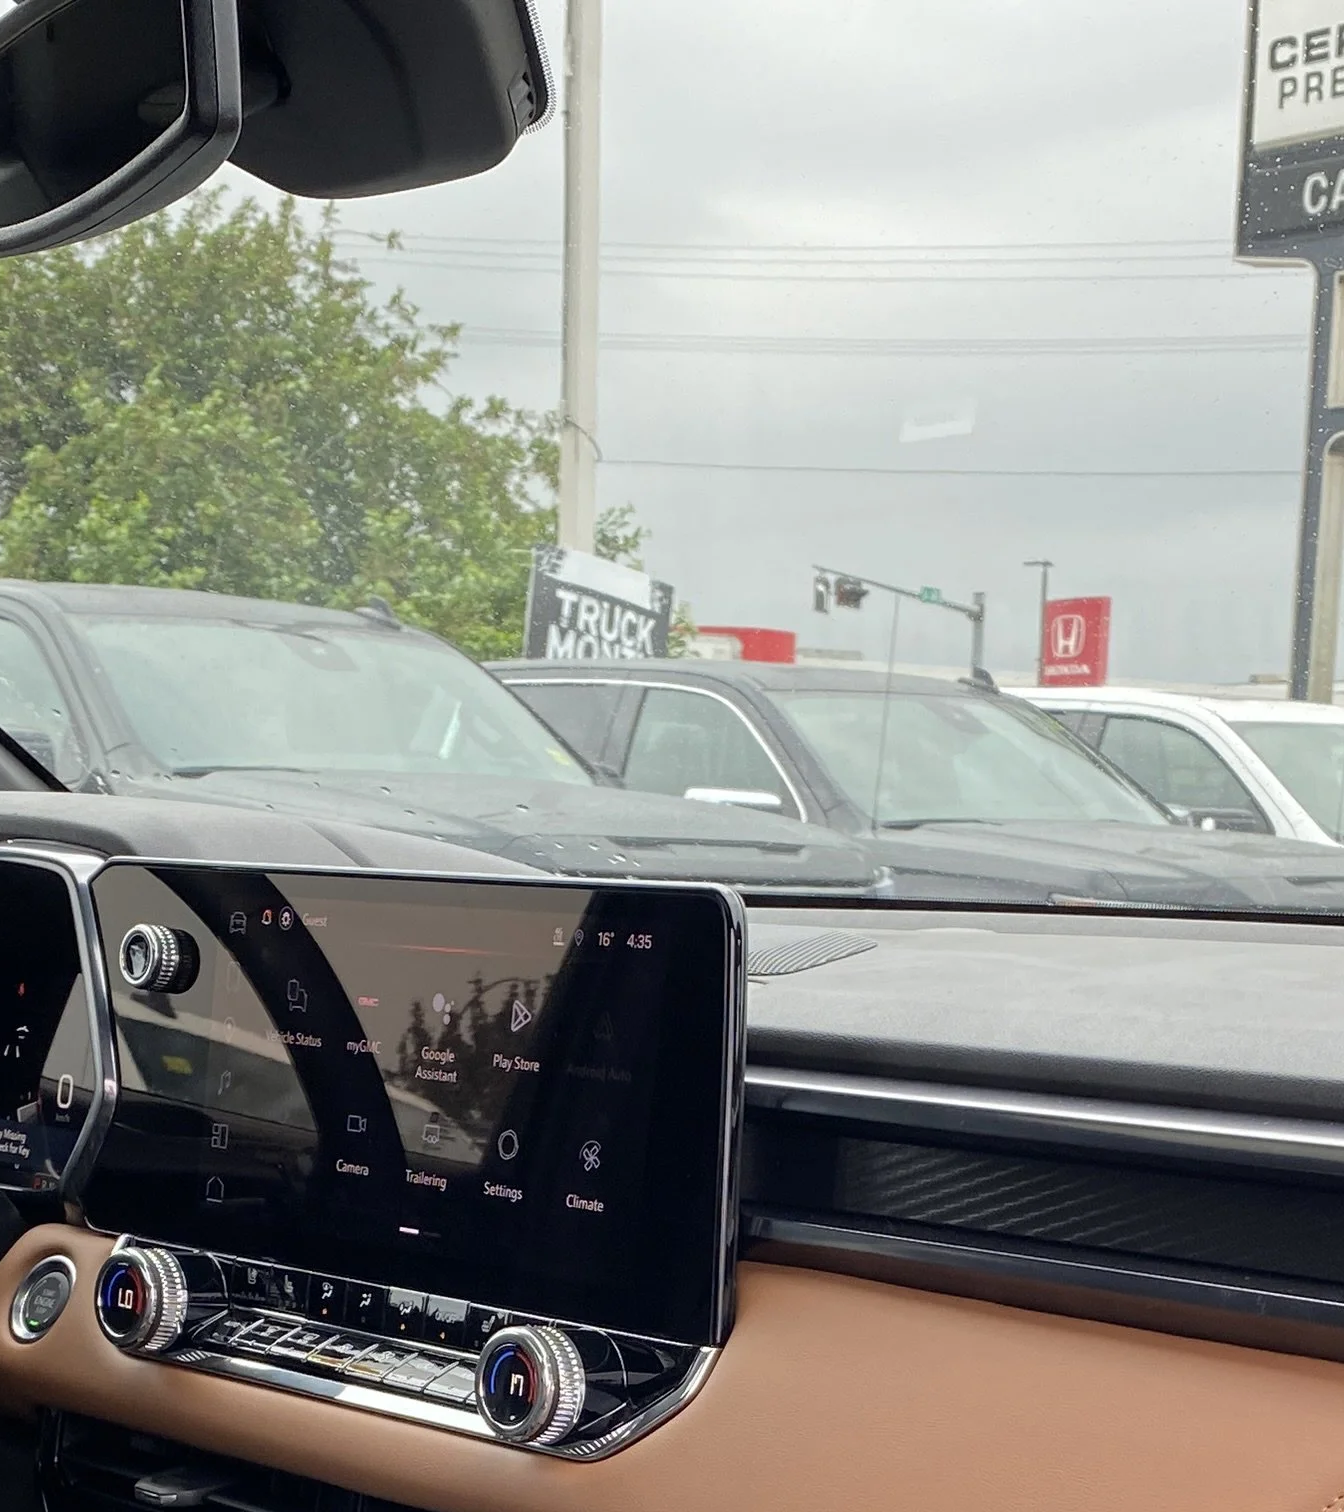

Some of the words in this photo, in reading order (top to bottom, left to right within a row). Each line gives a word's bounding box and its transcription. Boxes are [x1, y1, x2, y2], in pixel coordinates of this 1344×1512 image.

[555, 587, 656, 656] TRUCK
[303, 913, 328, 928] Guest
[627, 933, 653, 949] 4:35
[266, 1029, 295, 1046] Vehicle
[296, 1032, 322, 1048] Status
[346, 1039, 381, 1054] myGMC
[421, 1046, 455, 1066] Google
[492, 1053, 513, 1072] Play
[514, 1056, 540, 1072] Store
[415, 1065, 457, 1083] Assistant
[56, 1073, 74, 1109] 0
[18, 1145, 30, 1159] Key
[336, 1158, 369, 1176] Camera
[405, 1168, 447, 1192] Trailering
[483, 1181, 523, 1203] Settings
[566, 1193, 604, 1213] Climate
